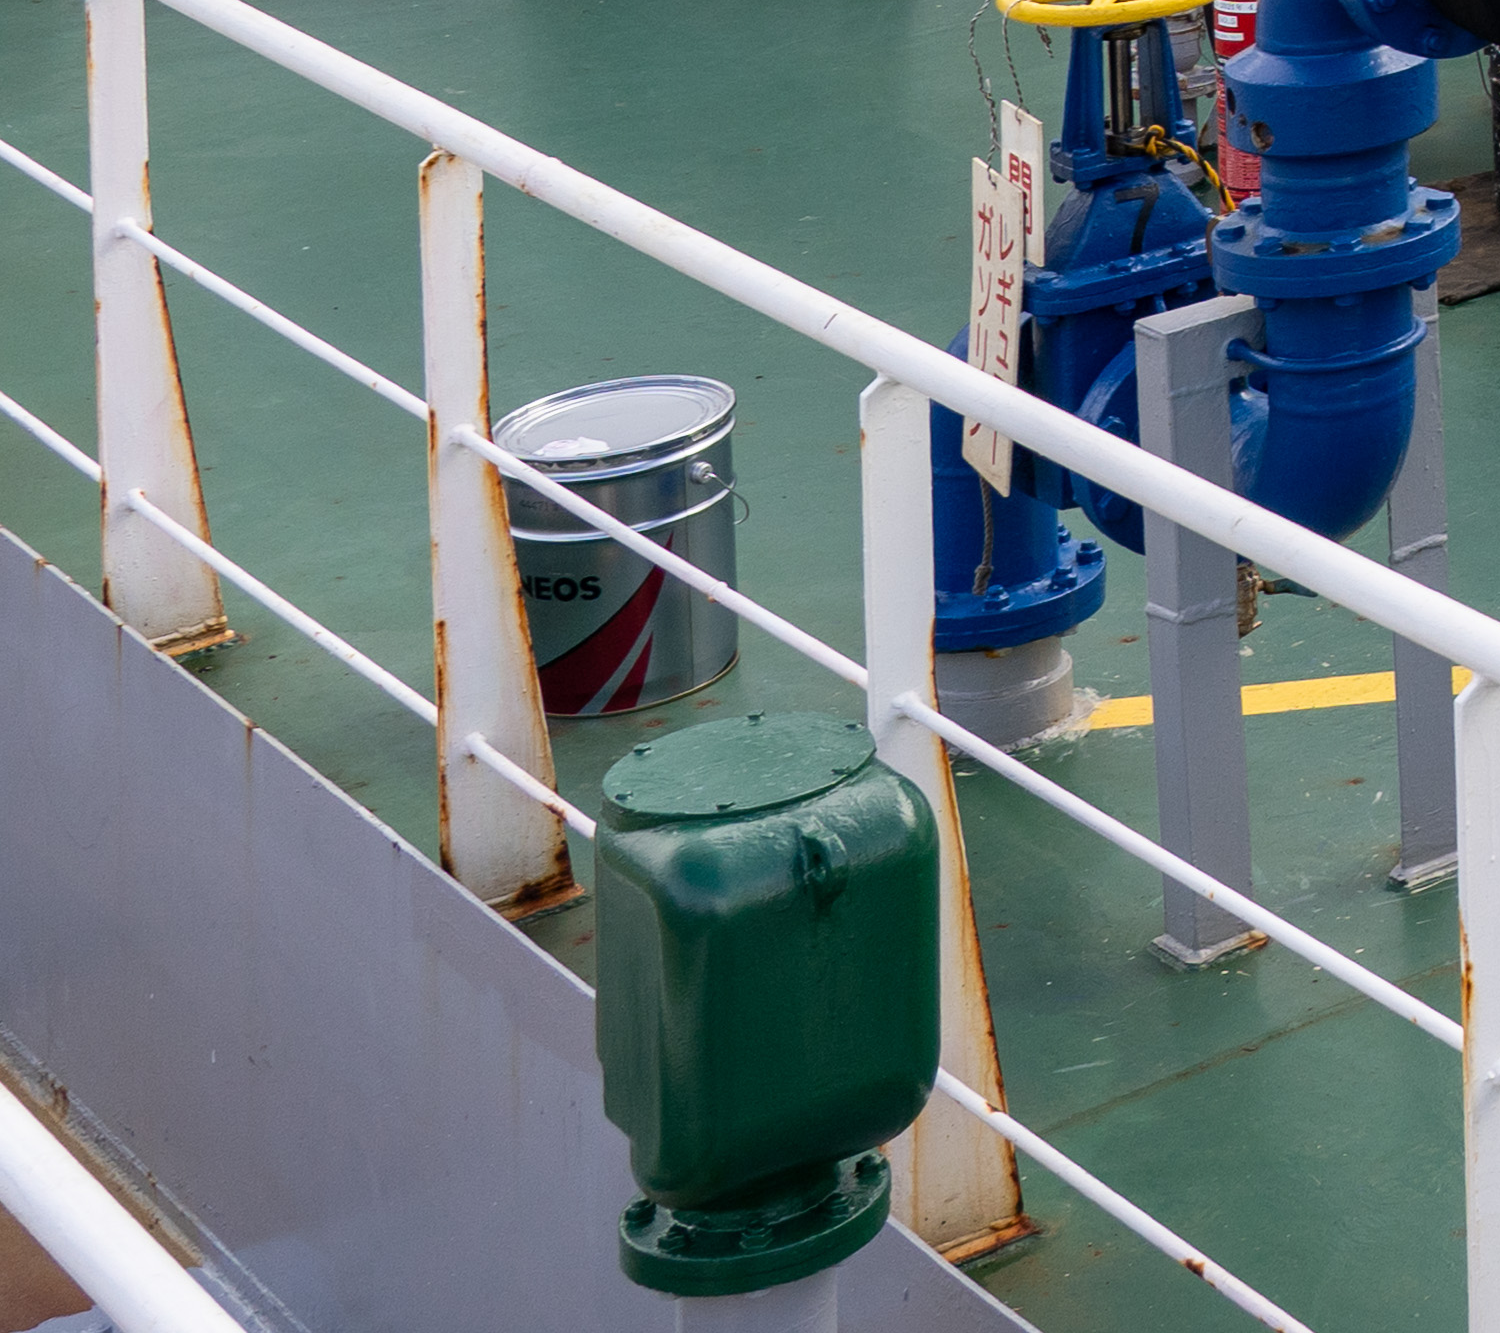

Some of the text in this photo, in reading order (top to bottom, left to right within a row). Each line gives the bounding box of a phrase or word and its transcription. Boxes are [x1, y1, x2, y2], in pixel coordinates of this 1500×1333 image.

[1115, 183, 1159, 254] 7
[970, 202, 993, 436] ガソリ
[992, 213, 1014, 465] レギュー
[521, 575, 601, 602] NEOS
